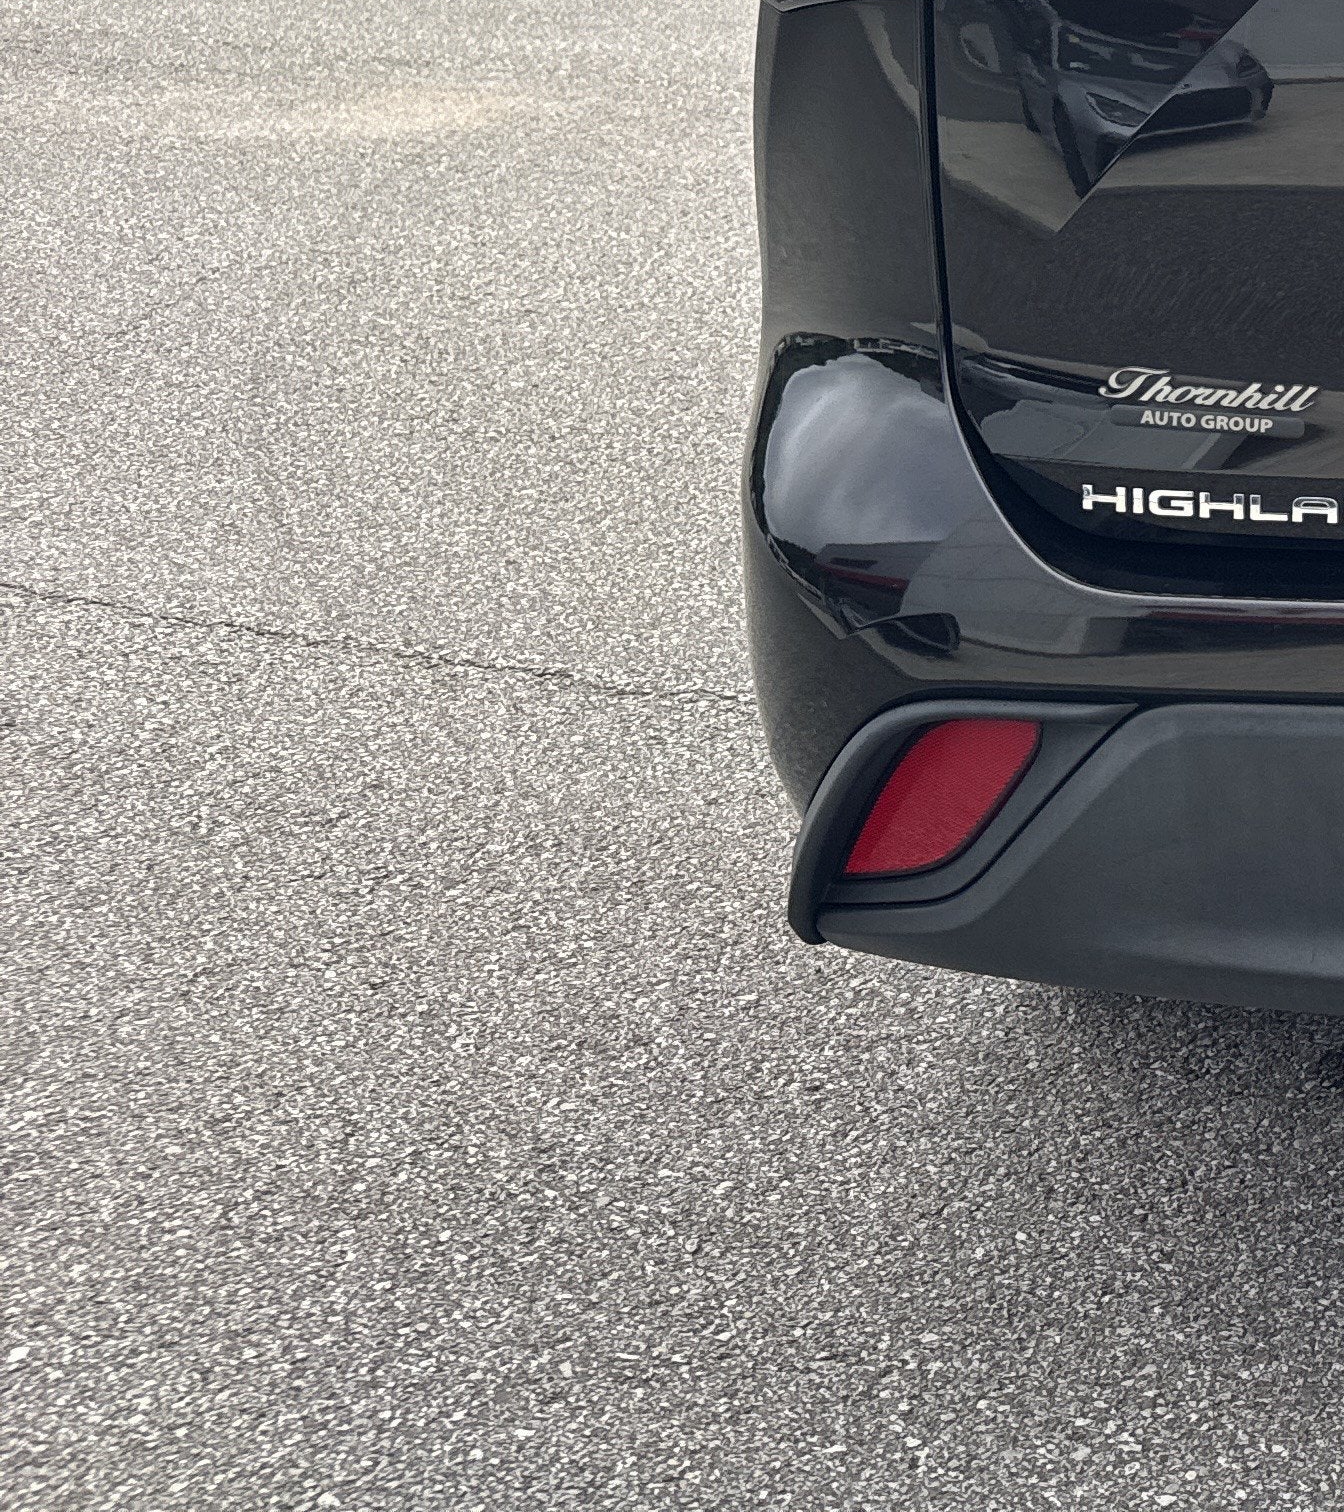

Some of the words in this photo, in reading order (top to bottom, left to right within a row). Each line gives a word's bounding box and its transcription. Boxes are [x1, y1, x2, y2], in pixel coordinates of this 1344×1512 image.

[1098, 365, 1320, 413] Thornhill
[1140, 410, 1197, 430] AUTO
[1200, 414, 1274, 435] GROUP
